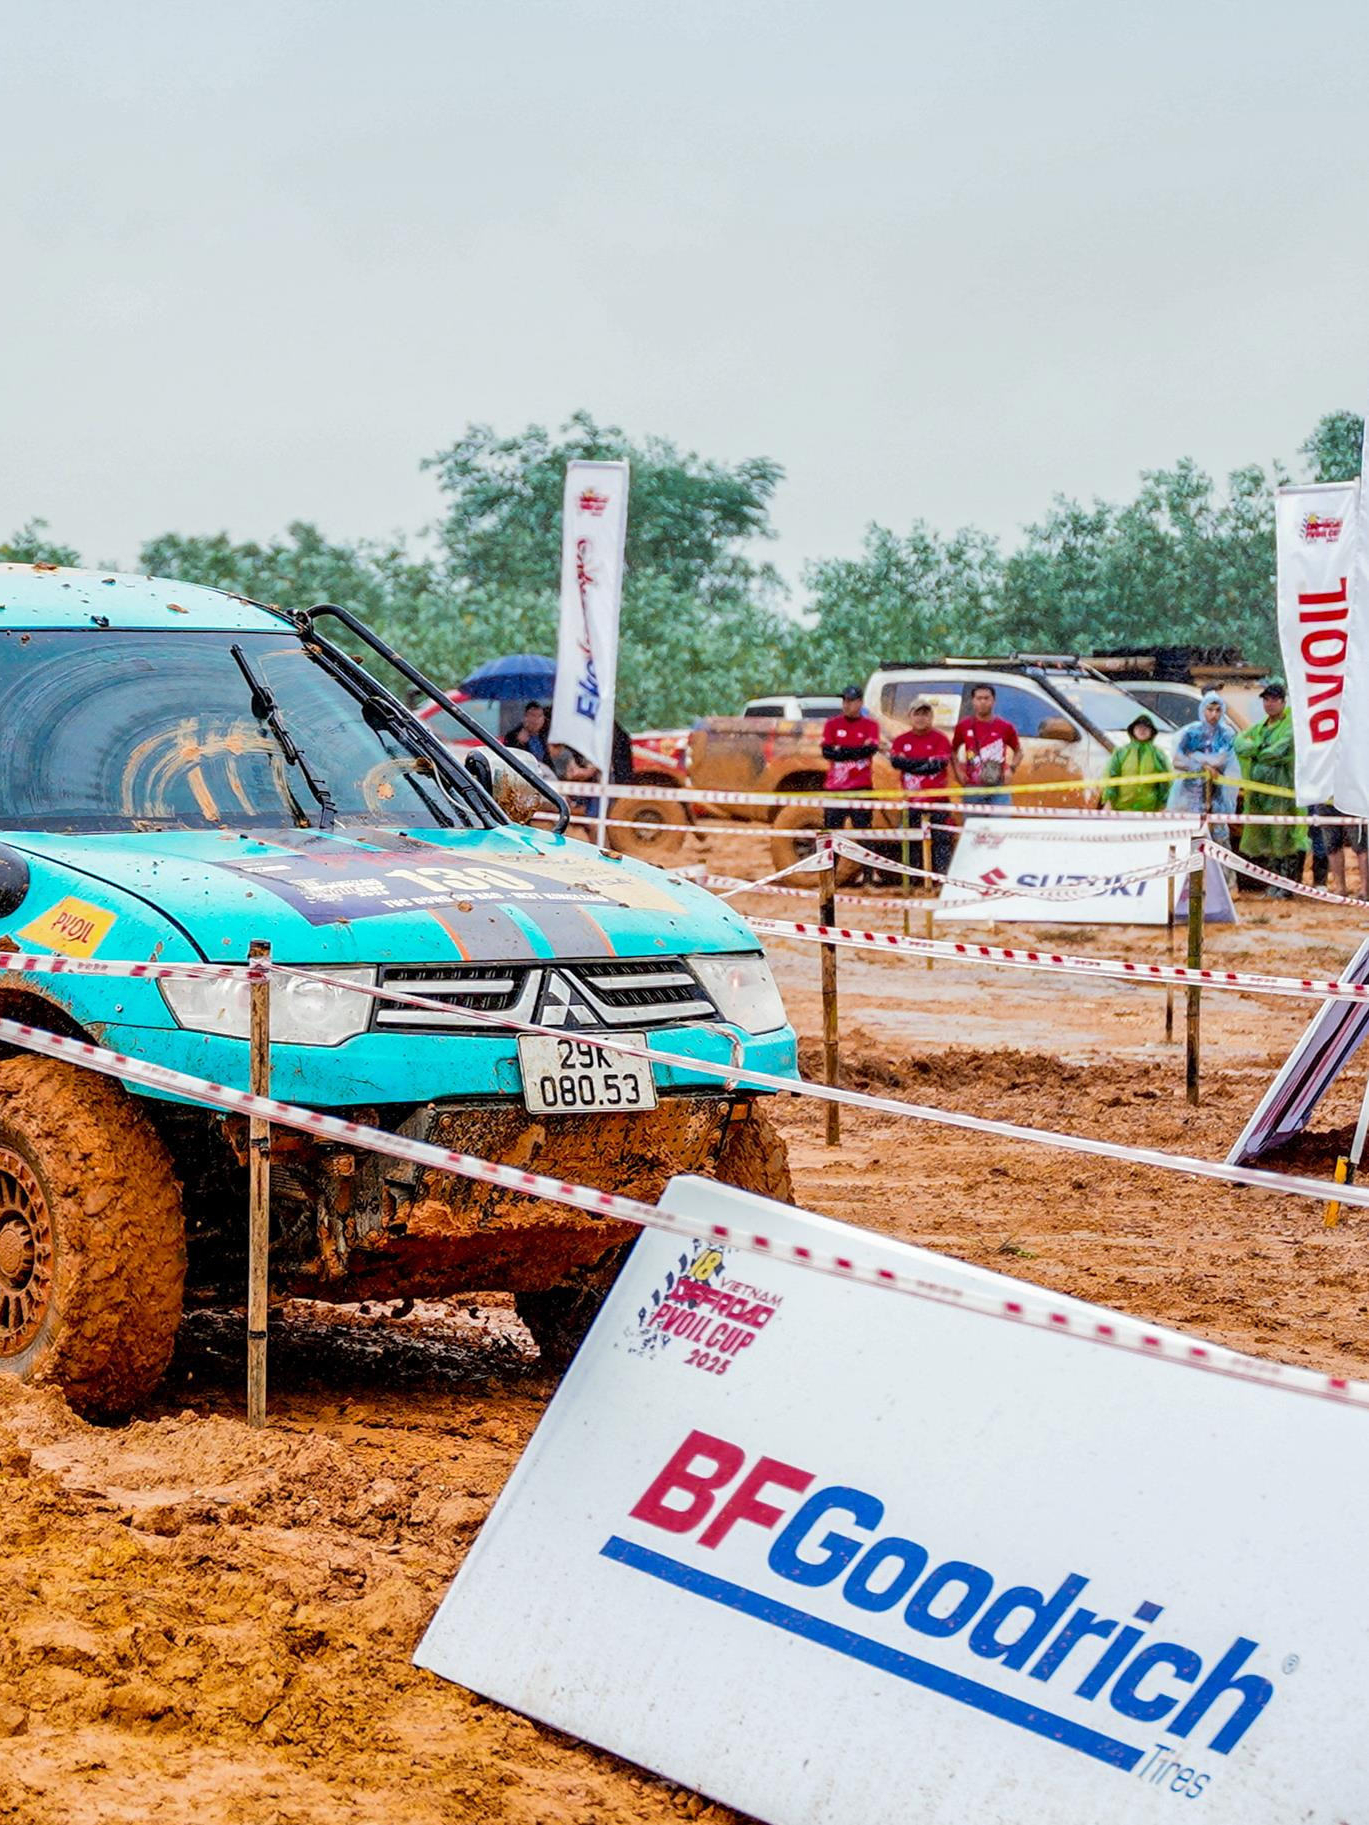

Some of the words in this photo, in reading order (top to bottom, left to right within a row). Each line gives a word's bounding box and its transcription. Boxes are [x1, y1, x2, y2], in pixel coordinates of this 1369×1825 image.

[1297, 576, 1349, 744] PVOIL
[384, 867, 535, 893] 130
[49, 911, 95, 944] PVOIL
[557, 1039, 612, 1070] 29K
[540, 1073, 641, 1107] 080.53
[687, 1248, 724, 1281] 18
[667, 1276, 776, 1331] OFFROAD
[719, 1276, 784, 1308] VIETNAM
[647, 1302, 713, 1344] PVOIL
[705, 1322, 757, 1357] CUP
[684, 1348, 733, 1376] 2025
[629, 1430, 1274, 1755] BFGoodrich
[1138, 1743, 1212, 1800] Tires
